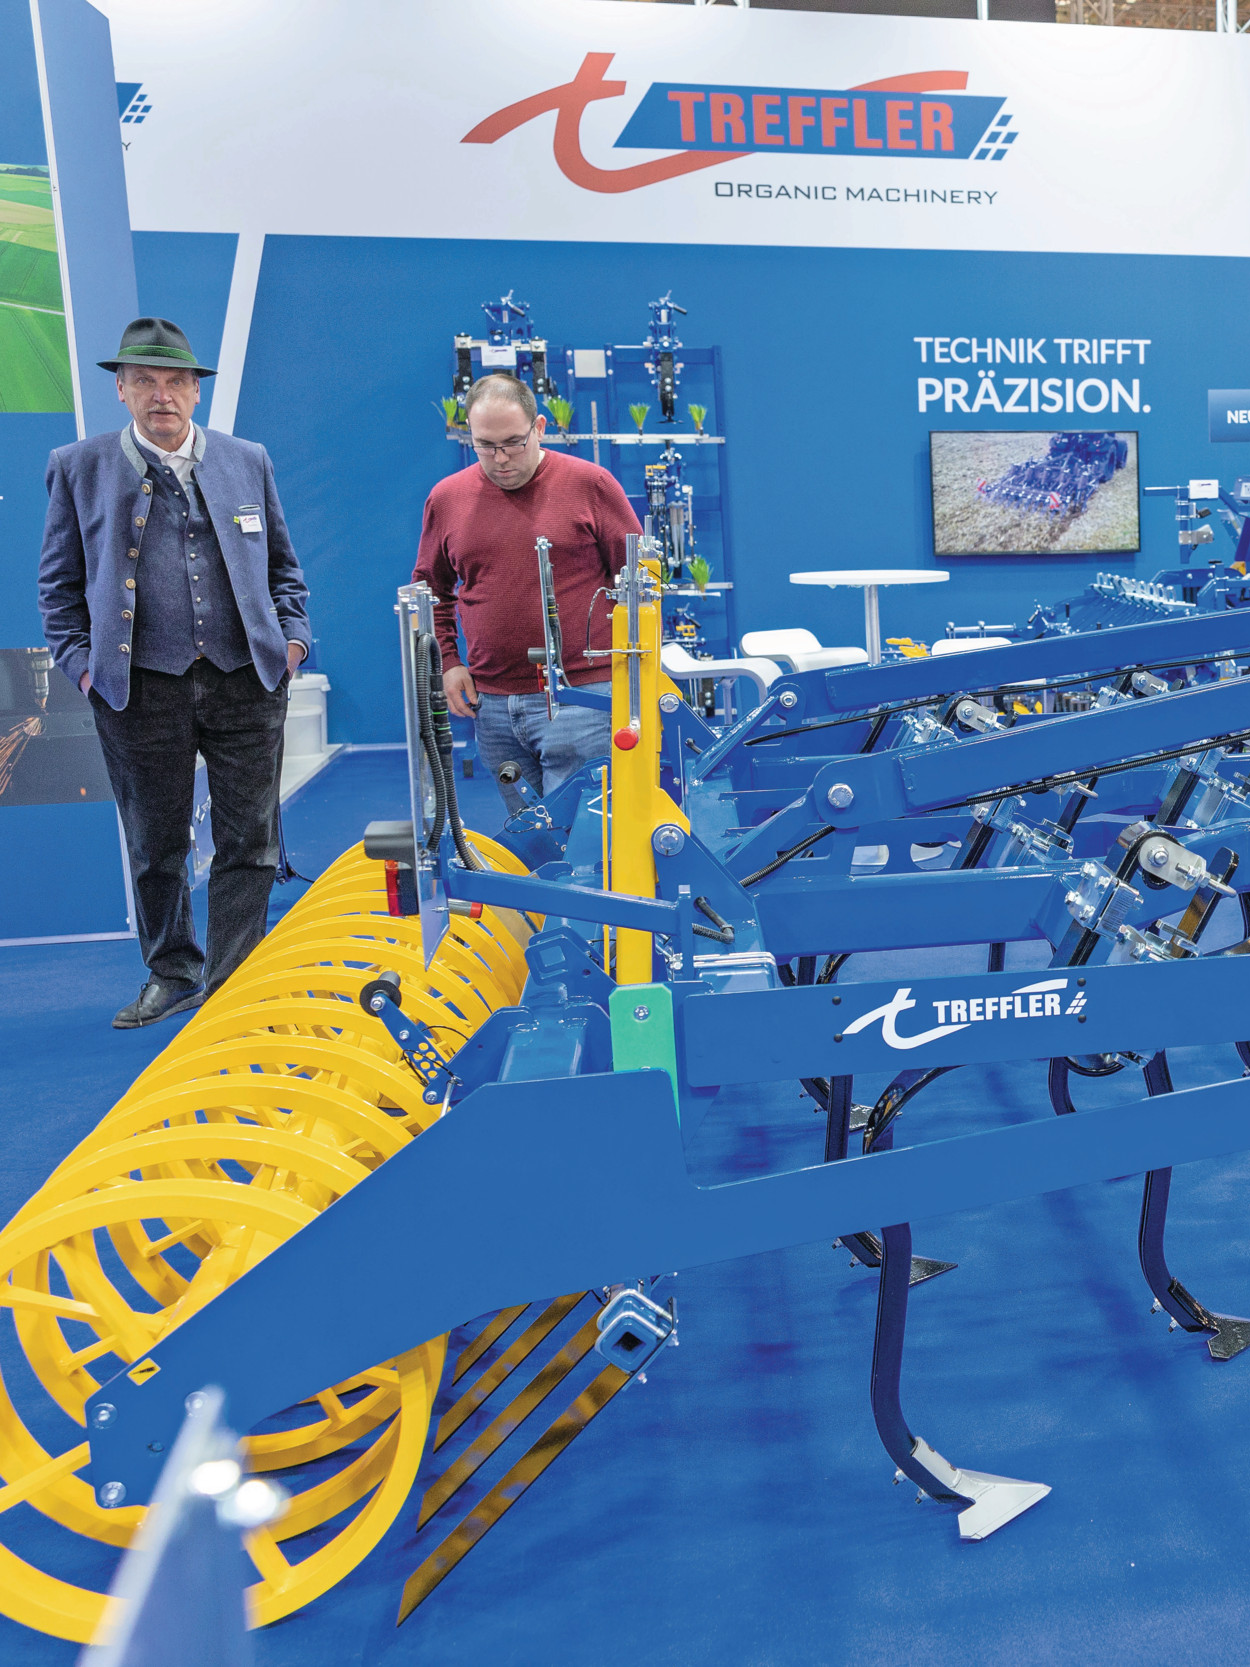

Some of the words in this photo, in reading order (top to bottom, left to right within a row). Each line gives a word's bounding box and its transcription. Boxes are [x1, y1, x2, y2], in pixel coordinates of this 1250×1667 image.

[667, 91, 955, 151] TREFFLER
[714, 181, 838, 201] ORGANIC
[845, 186, 998, 205] MACHINERY
[913, 336, 1047, 364] TECHNIK
[1053, 338, 1152, 365] TRIFFT
[917, 369, 1152, 413] PRÄZISION.
[932, 993, 1061, 1024] TREFFLER
